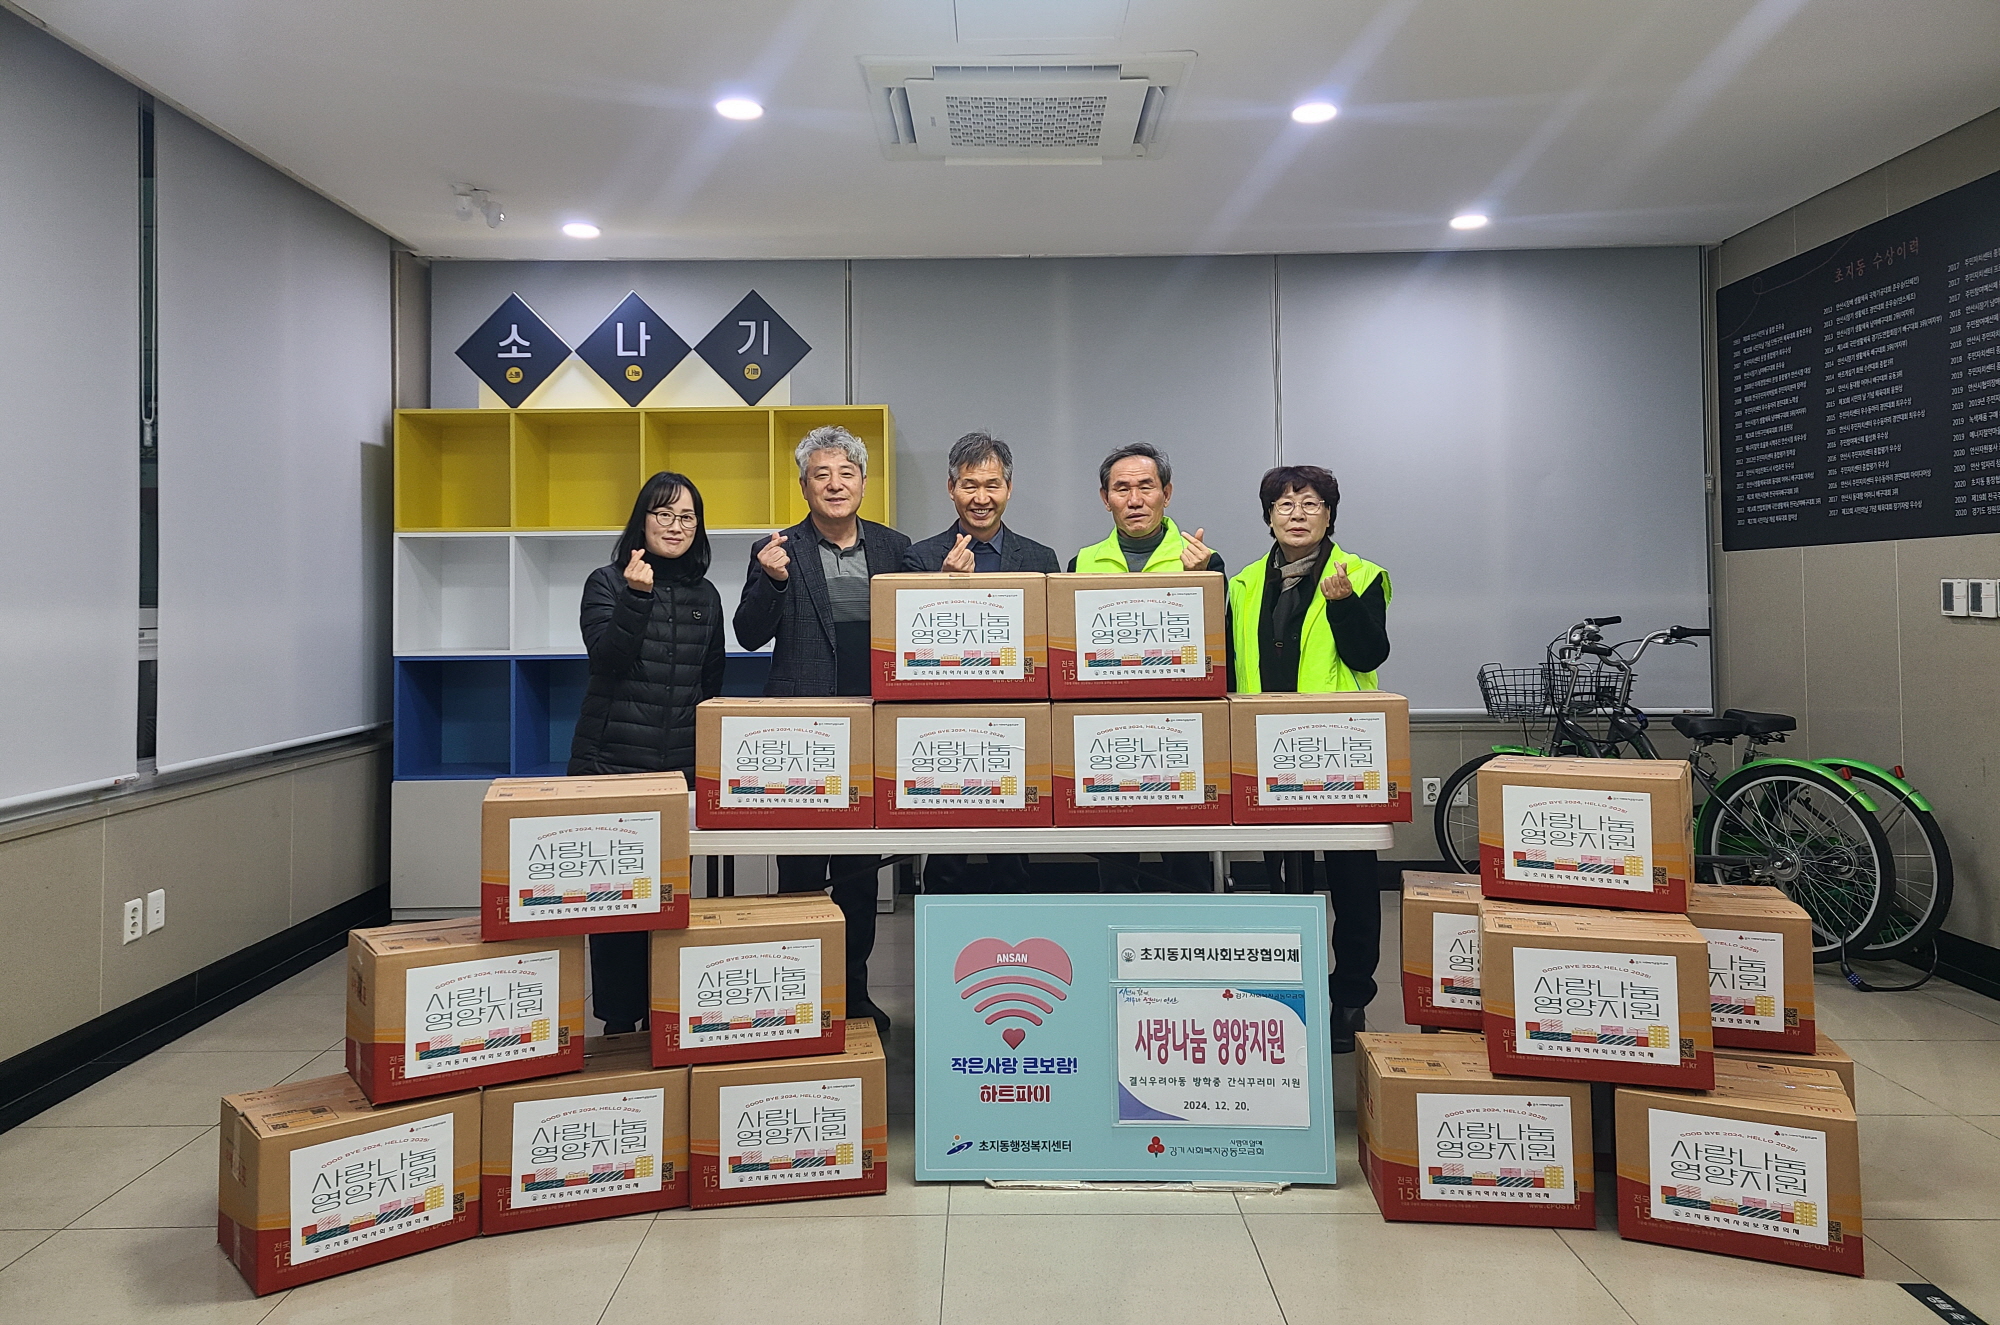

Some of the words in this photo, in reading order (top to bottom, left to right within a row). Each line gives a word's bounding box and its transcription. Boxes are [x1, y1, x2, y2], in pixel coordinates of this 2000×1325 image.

[1835, 258, 1866, 283] 초지동
[1873, 237, 1919, 270] 수상이력
[497, 324, 532, 359] 소
[616, 321, 651, 357] 나
[737, 320, 769, 356] 기
[627, 368, 641, 377] 나눔
[1972, 507, 1986, 516] 경기도
[912, 611, 1009, 627] 사랑나눔
[1091, 609, 1189, 627] 사랑나눔
[911, 628, 1009, 644] 영양지원
[1091, 626, 1190, 644] 영양지원
[737, 739, 835, 755] 사랑나눔
[912, 740, 1011, 755] 사랑나눔
[1090, 736, 1189, 753] 사랑나눔
[1272, 735, 1371, 752] 사랑나눔
[736, 756, 835, 772] 영양지원
[912, 757, 1011, 773] 영양지원
[1090, 752, 1189, 770] 영양지원
[1273, 752, 1372, 770] 영양지원
[1520, 810, 1634, 833] 사랑나눔
[529, 837, 643, 861] 사랑나눔
[1521, 827, 1635, 852] 영양지원
[528, 856, 643, 880] 영양지원
[996, 952, 1029, 964] ANSAN
[1140, 947, 1300, 964] 초지동지역사회보장협의체
[698, 964, 805, 988] 사랑나눔
[1709, 972, 1767, 992] 지원
[425, 978, 542, 1012] 사랑나눔
[697, 983, 805, 1008] 영양지원
[1533, 975, 1658, 1000] 사랑나눔
[425, 997, 542, 1032] 영양지원
[1534, 994, 1659, 1021] 영양지원
[1134, 1018, 1206, 1065] 사랑나눔
[1212, 1017, 1287, 1066] 영양지원
[951, 1057, 1018, 1075] 작은사랑
[1022, 1056, 1078, 1075] 큰보람!
[1128, 1076, 1187, 1088] 결식우려아동
[1192, 1076, 1221, 1089] 방학중
[1227, 1076, 1276, 1089] 간식꾸러미
[1281, 1075, 1301, 1089] 지원
[979, 1084, 1051, 1104] 하트파이
[1183, 1099, 1211, 1112] 2024.
[1214, 1099, 1230, 1112] 12.
[1234, 1099, 1251, 1112] 20.
[737, 1104, 846, 1128] 사랑나눔
[532, 1115, 647, 1145] 사랑나눔
[737, 1123, 846, 1147] 영양지원
[1436, 1120, 1554, 1141] 사랑나눔
[531, 1134, 646, 1165] 영양지원
[978, 1138, 1072, 1153] 초지동행정복지센터
[1169, 1146, 1185, 1157] 경기
[1187, 1146, 1264, 1157] 사회복지공동모금회
[1437, 1140, 1555, 1161] 영양지원
[1670, 1139, 1805, 1176] 사랑나눔
[312, 1144, 436, 1193] 사랑나눔
[1670, 1159, 1806, 1198] 영양지원
[311, 1164, 436, 1215] 영양지원
[1397, 1176, 1412, 1186] 전국
